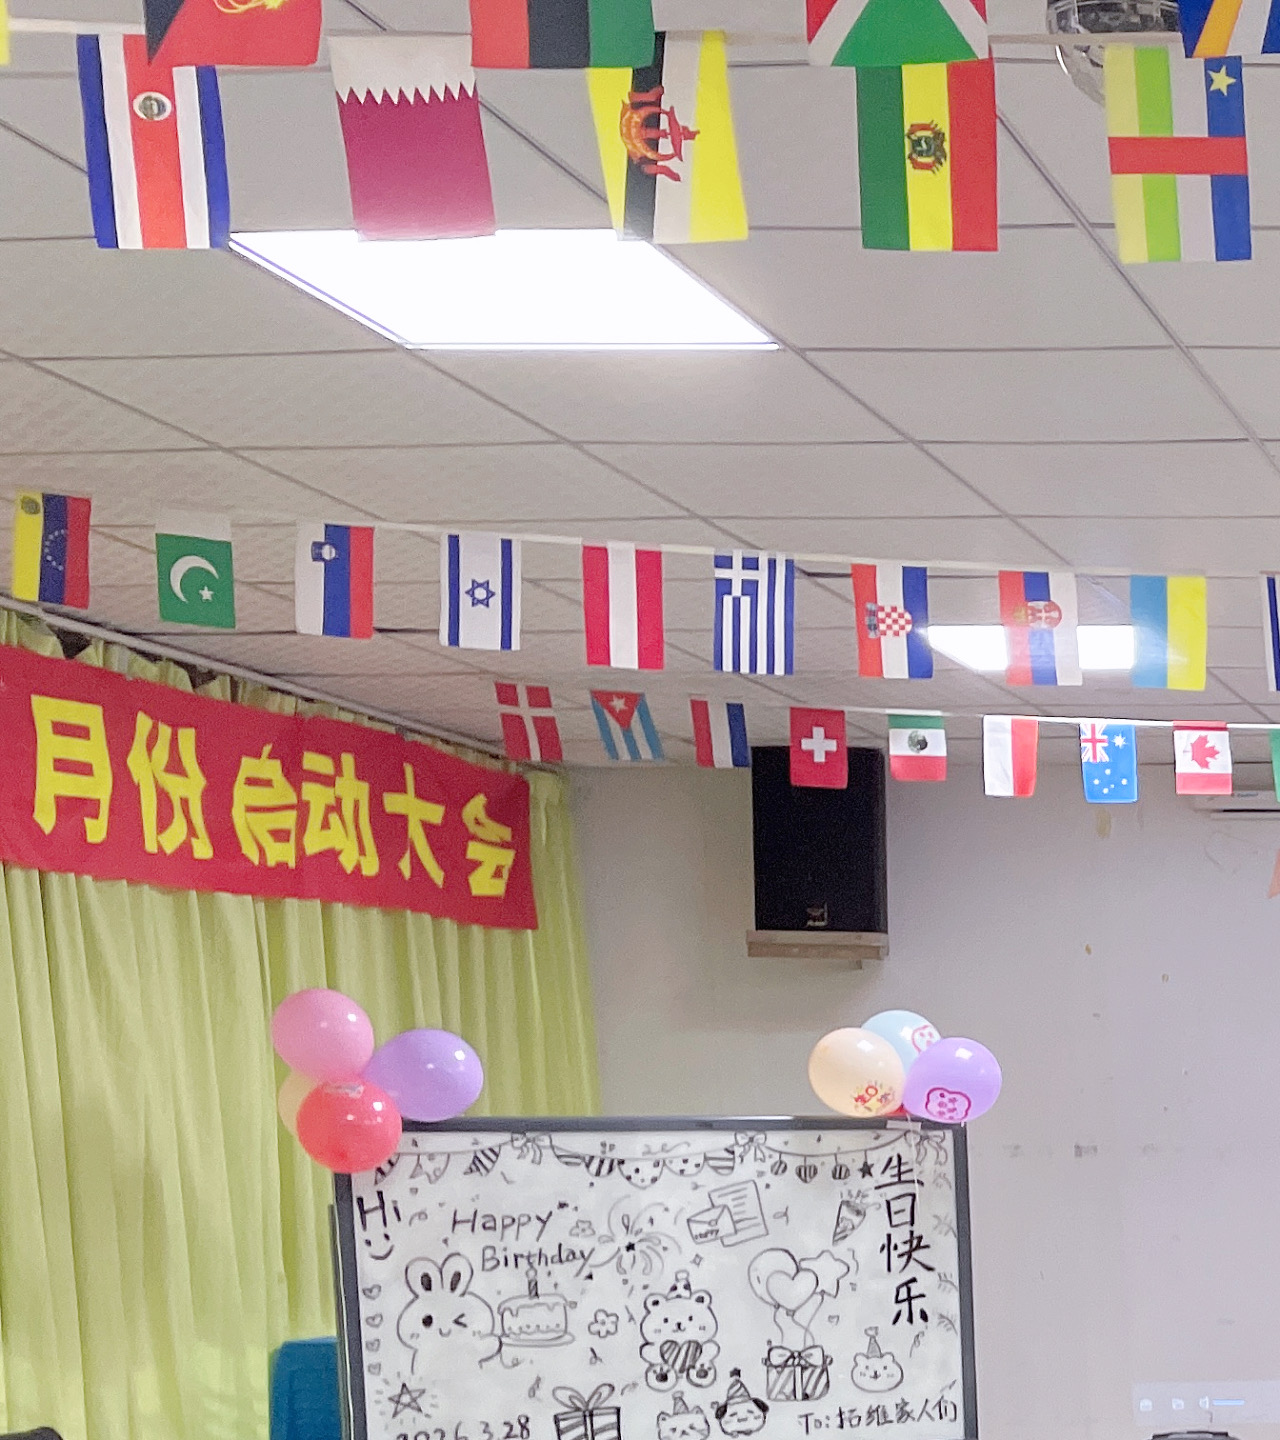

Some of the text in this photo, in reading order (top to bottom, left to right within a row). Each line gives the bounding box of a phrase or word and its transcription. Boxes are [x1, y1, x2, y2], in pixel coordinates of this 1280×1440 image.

[30, 694, 517, 898] 月份启动大会
[356, 1190, 402, 1232] Hi
[451, 1208, 554, 1242] Happy
[874, 1152, 936, 1326] 生日快乐
[481, 1243, 596, 1278] Birthday
